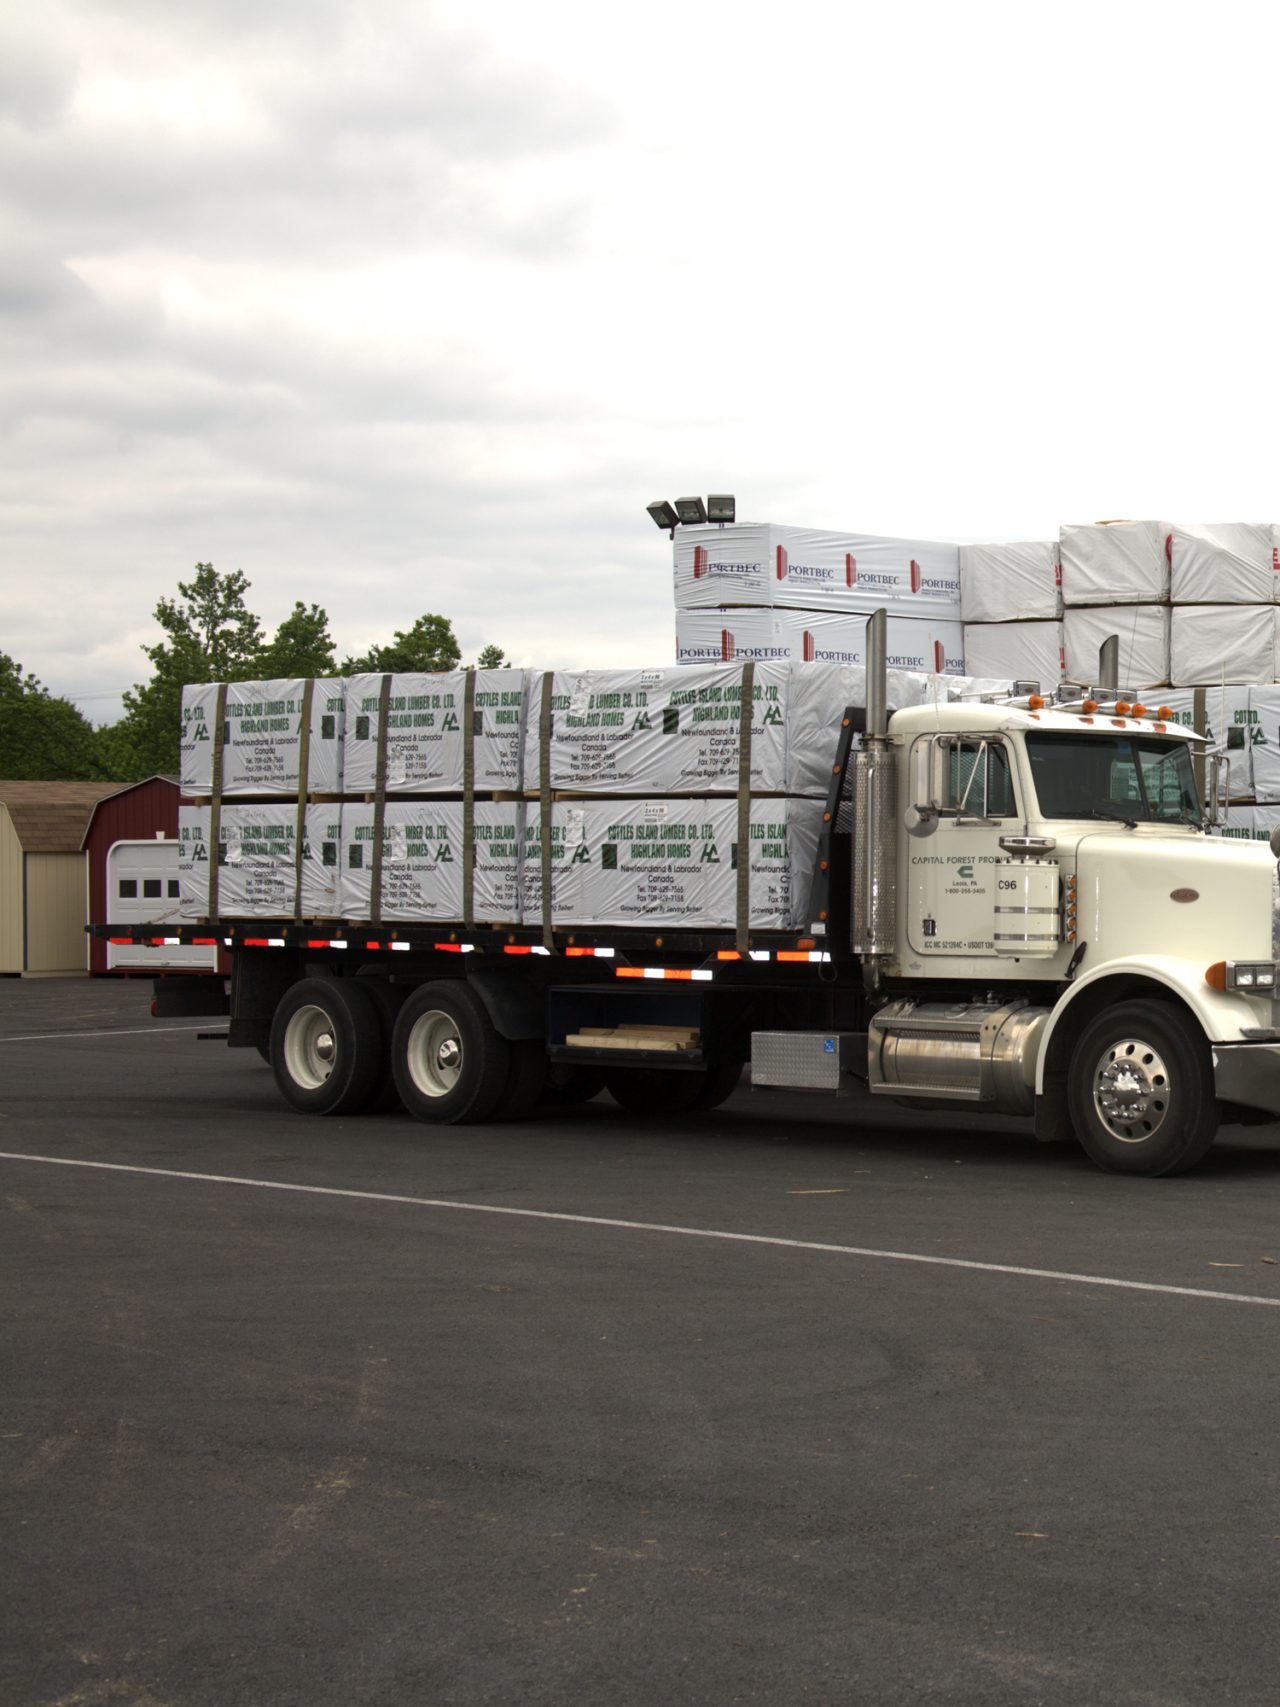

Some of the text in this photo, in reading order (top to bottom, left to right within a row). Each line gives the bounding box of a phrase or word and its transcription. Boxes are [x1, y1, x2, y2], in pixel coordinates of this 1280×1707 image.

[789, 565, 834, 578] PORTBEC
[857, 573, 899, 585] PORTBEC
[736, 648, 790, 657] PORTBEC
[815, 651, 860, 662] PORTBEC
[886, 656, 924, 666] ORTBEC
[408, 694, 456, 709] LUMBER CO. LTD.
[596, 695, 620, 708] LUMBER
[623, 694, 634, 708] CO.
[636, 692, 648, 708] LTD.
[265, 701, 285, 715] LUMBER
[287, 701, 295, 714] CO.
[414, 714, 434, 726] HOMES
[602, 712, 624, 726] HOMES
[1182, 711, 1193, 725] CO.
[269, 718, 289, 732] HOMES
[193, 827, 203, 840] LTD.
[425, 826, 435, 839] CO.
[494, 826, 515, 839] ISLAND
[608, 824, 715, 839] COTTLES ISLAND LUMBER CO. LTD.
[631, 844, 691, 858] HIGHLAND HOMES
[947, 856, 975, 864] FOREST
[621, 865, 667, 873] Newfoundland
[648, 875, 674, 883] Canada
[999, 880, 1017, 890] C96
